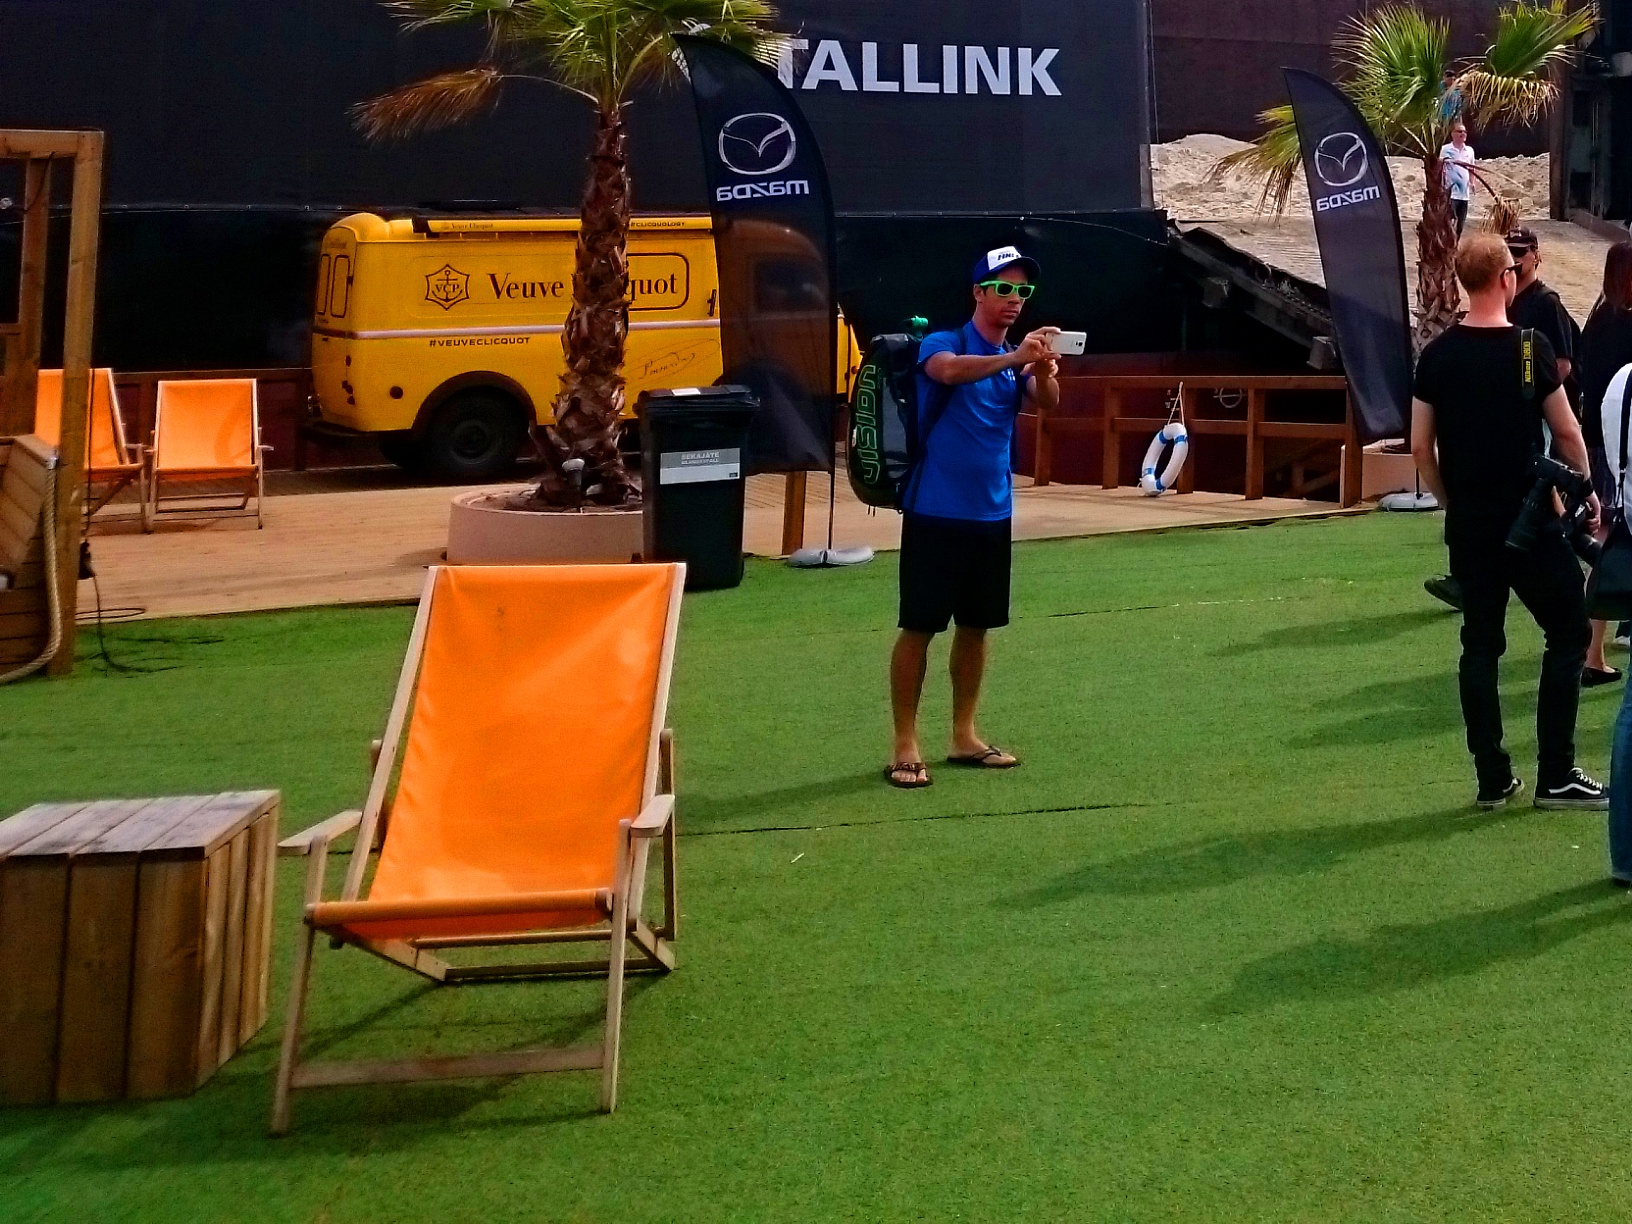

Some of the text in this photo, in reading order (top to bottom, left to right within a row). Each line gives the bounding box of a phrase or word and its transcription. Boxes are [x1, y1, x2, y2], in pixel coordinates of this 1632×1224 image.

[763, 38, 1062, 97] TALLINK
[487, 272, 678, 301] Veuve quot
[430, 337, 530, 347] #VEUVECLICQUOT
